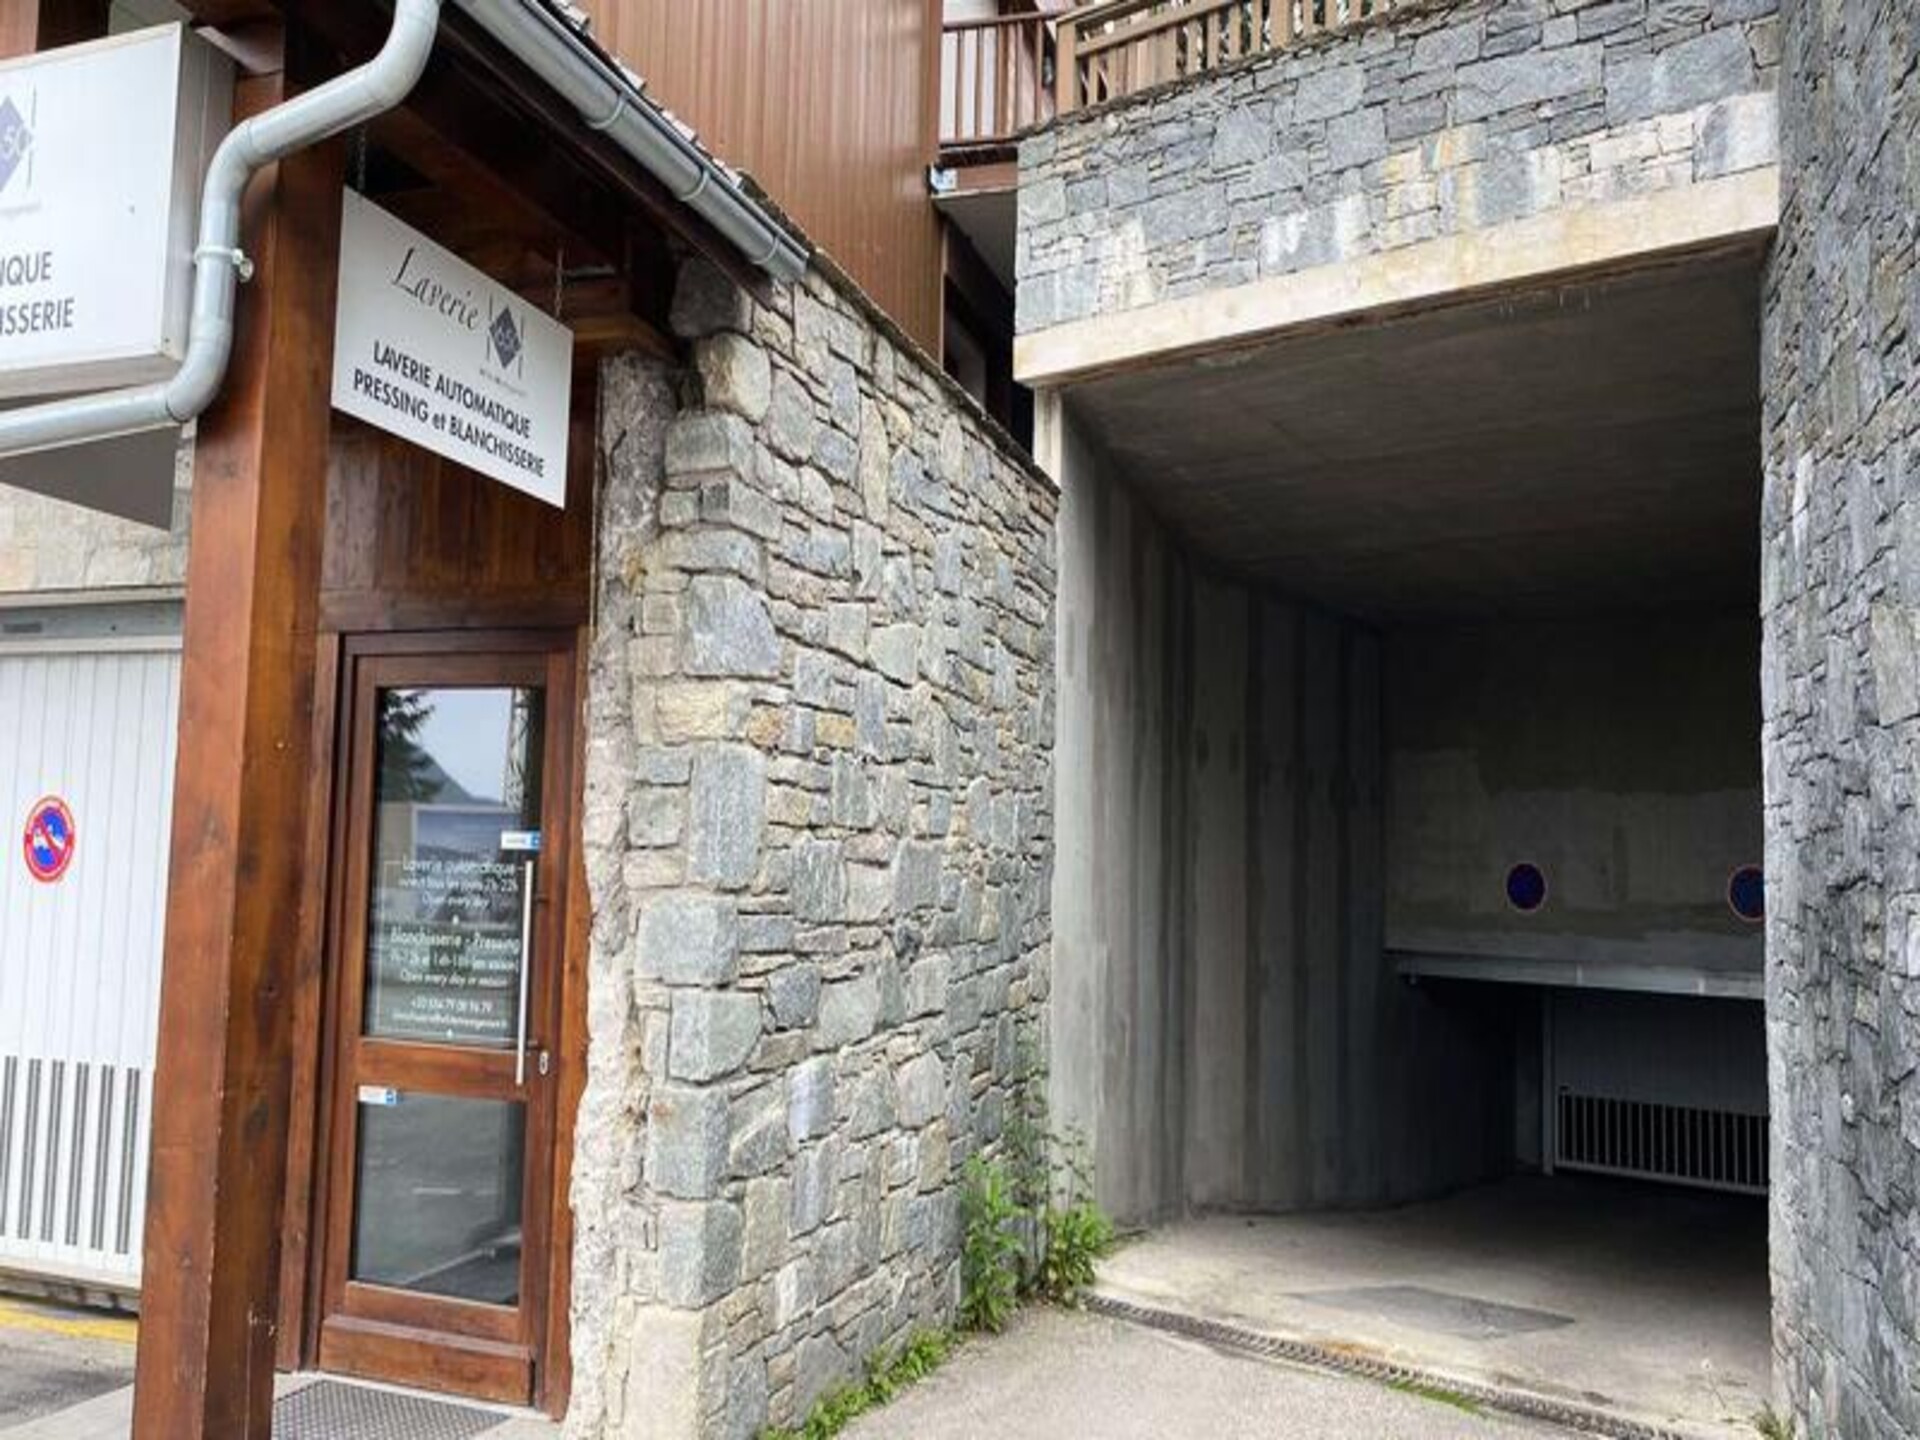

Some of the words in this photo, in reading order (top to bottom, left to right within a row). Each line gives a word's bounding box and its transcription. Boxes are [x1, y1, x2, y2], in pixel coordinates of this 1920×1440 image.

[391, 247, 479, 330] Laverie
[354, 368, 429, 423] PRESSING
[432, 413, 447, 432] et
[450, 415, 545, 479] BLANCHISSERIE
[373, 340, 432, 389] LAVERIE
[434, 373, 531, 439] AUTOMATIQUE
